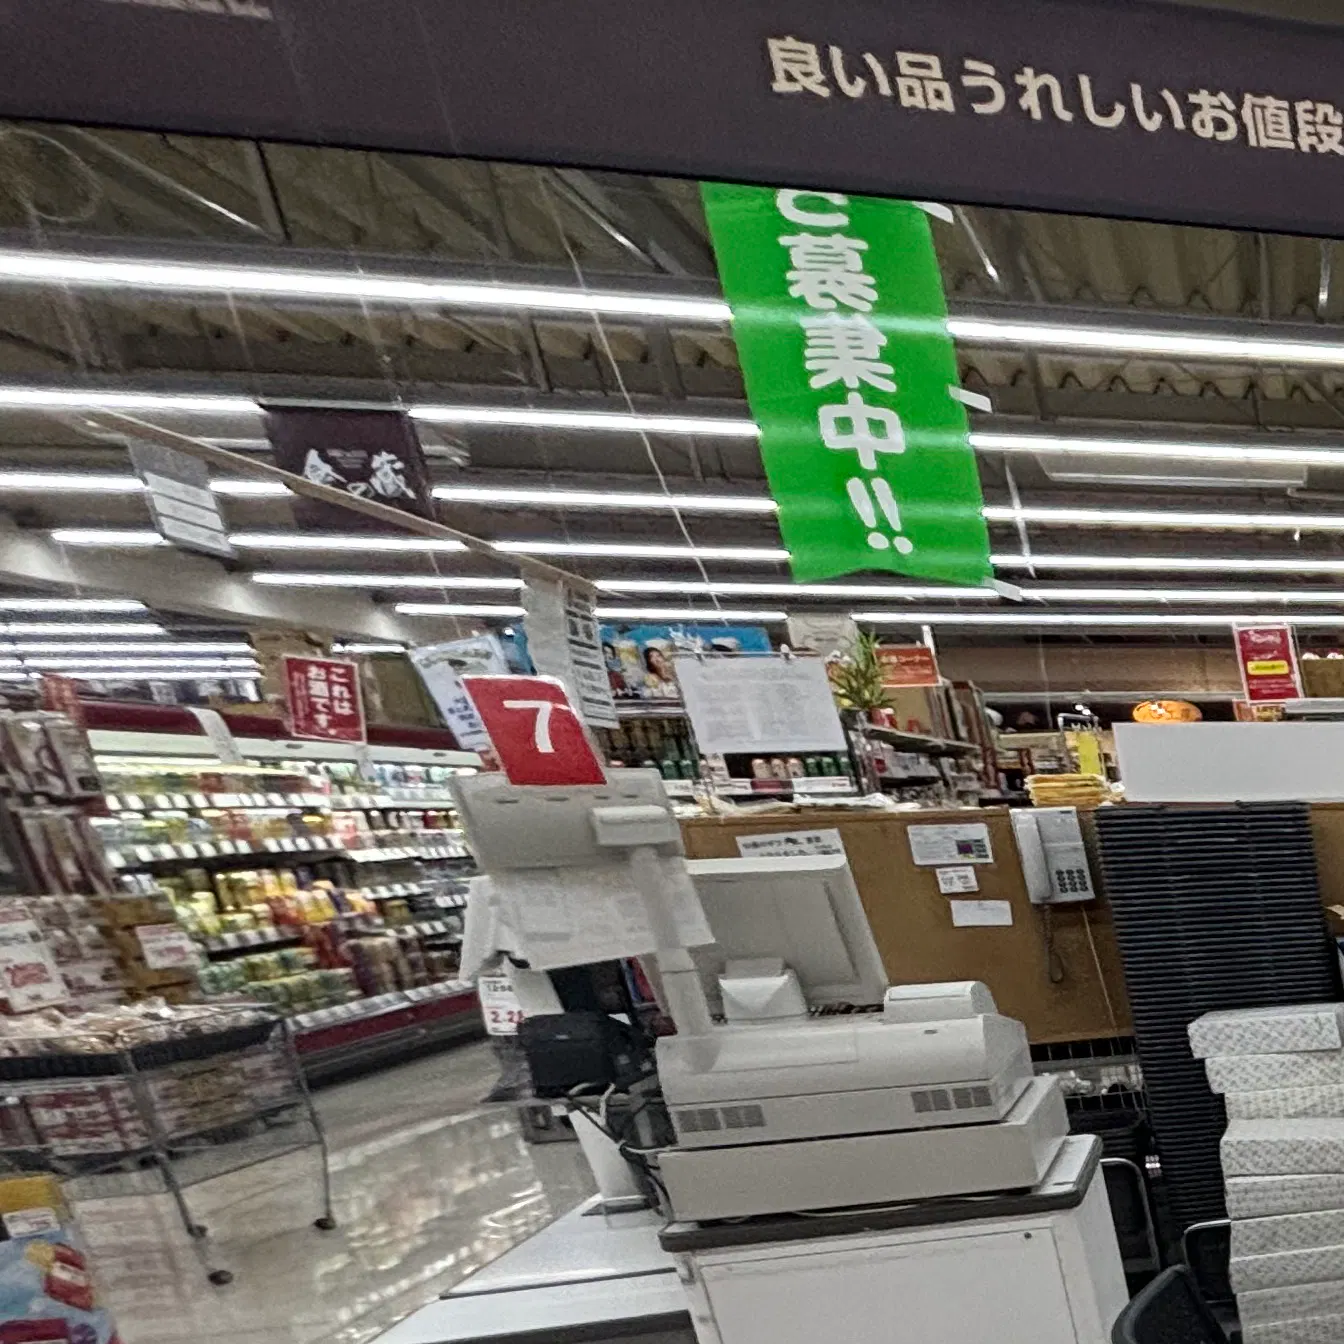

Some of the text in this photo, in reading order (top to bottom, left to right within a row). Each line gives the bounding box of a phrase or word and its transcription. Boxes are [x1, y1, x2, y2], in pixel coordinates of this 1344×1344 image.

[329, 666, 355, 716] これは
[502, 699, 554, 754] 7
